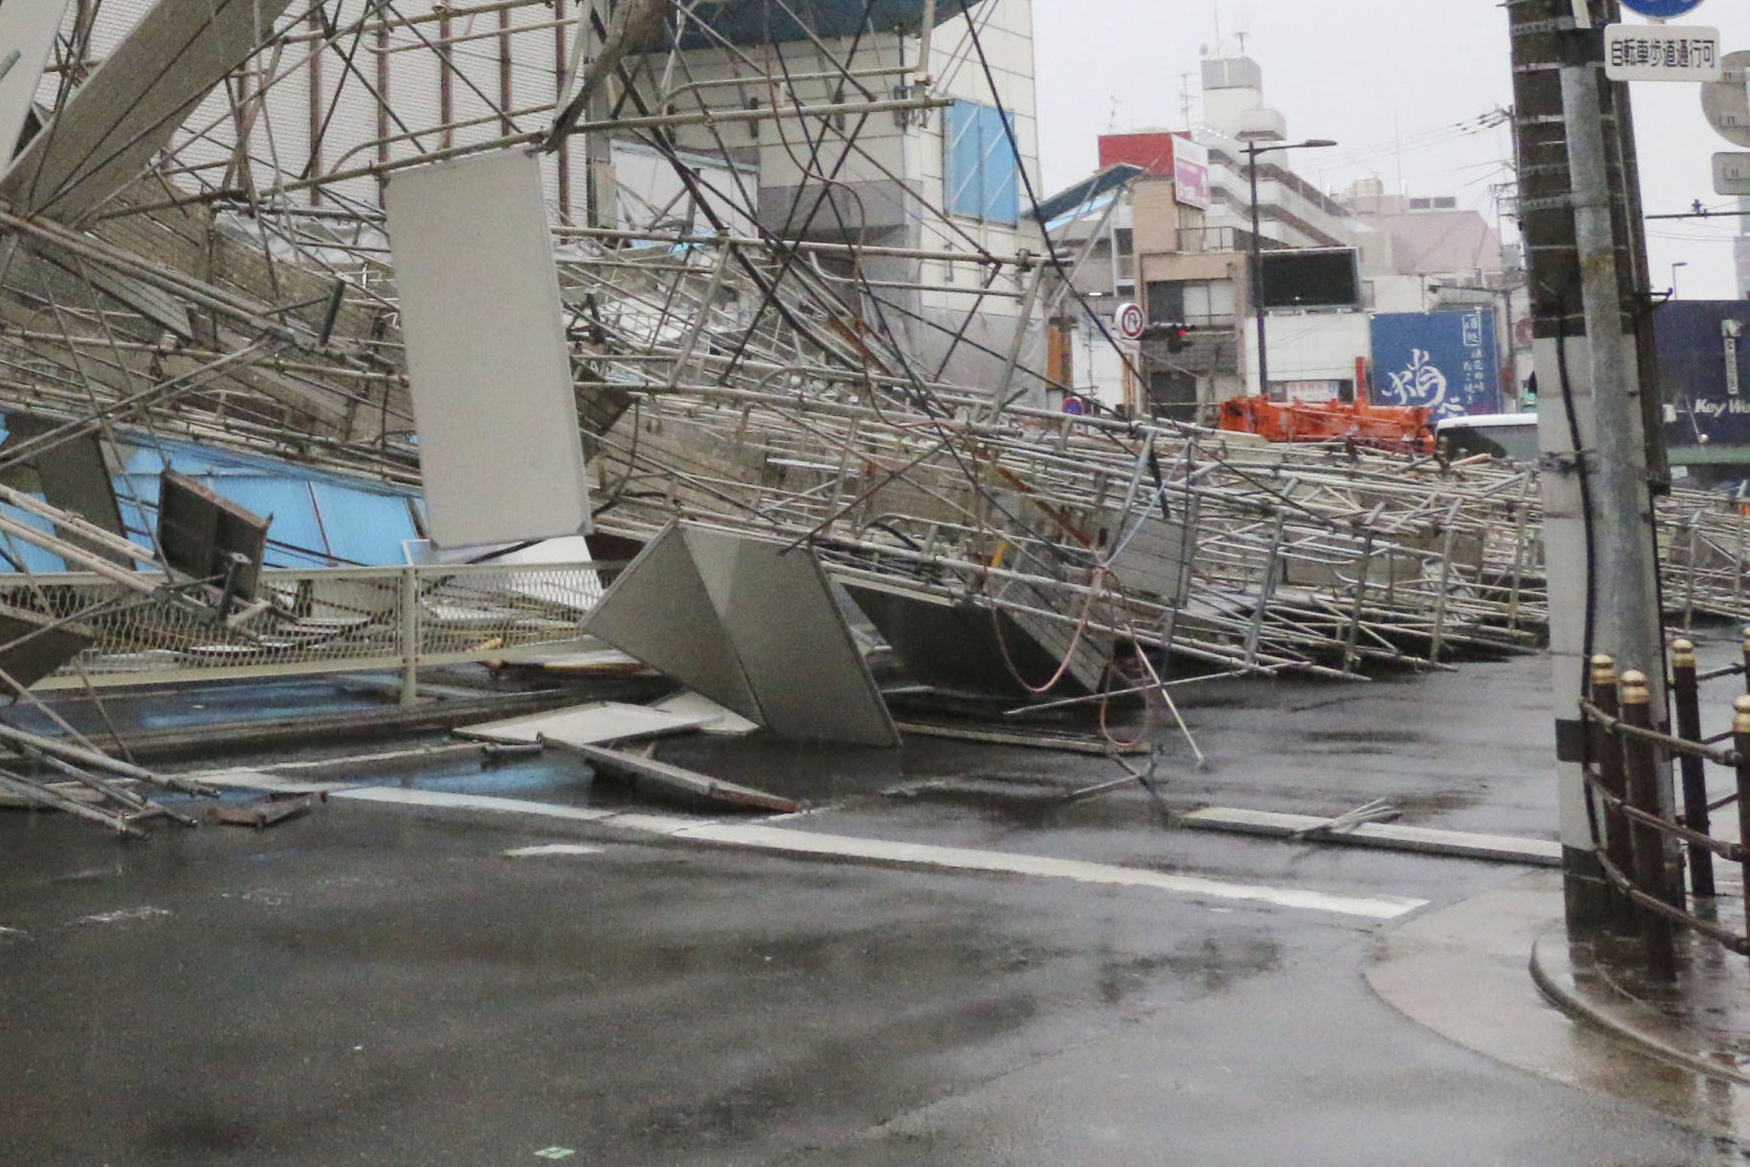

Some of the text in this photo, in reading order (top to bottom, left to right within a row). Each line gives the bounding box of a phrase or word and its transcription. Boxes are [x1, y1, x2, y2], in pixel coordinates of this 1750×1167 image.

[1611, 38, 1714, 68] 自転車歩道通行可
[1694, 398, 1728, 417] Key
